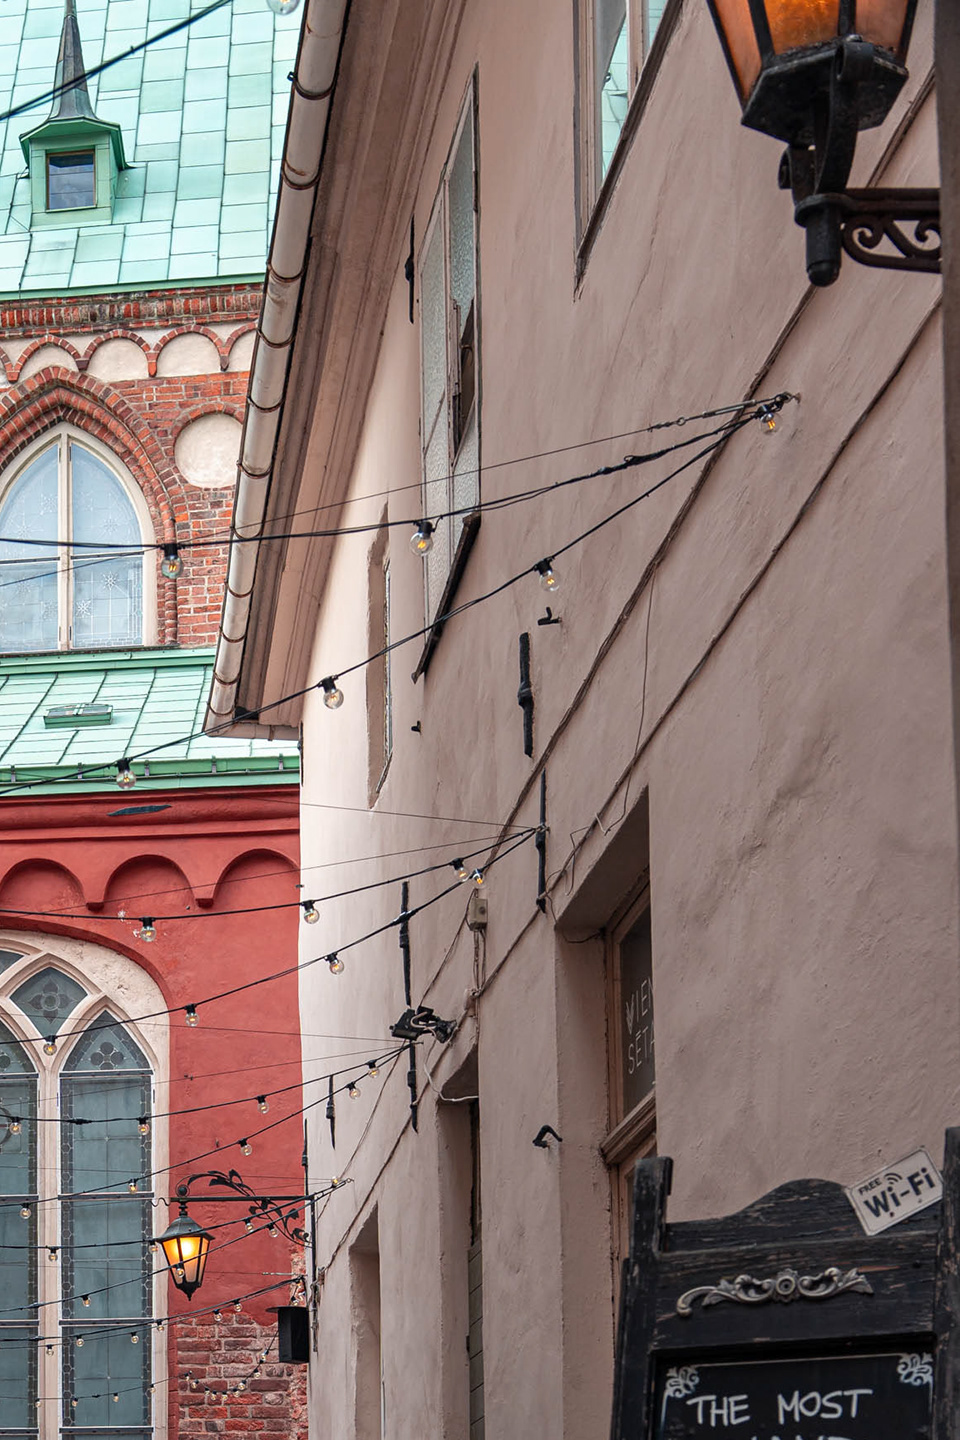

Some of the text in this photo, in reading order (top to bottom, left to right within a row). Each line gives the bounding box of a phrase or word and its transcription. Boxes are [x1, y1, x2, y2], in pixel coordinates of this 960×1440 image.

[858, 1177, 883, 1196] FREE
[863, 1167, 936, 1218] Wi-Fi
[686, 1388, 873, 1427] THE MOST
